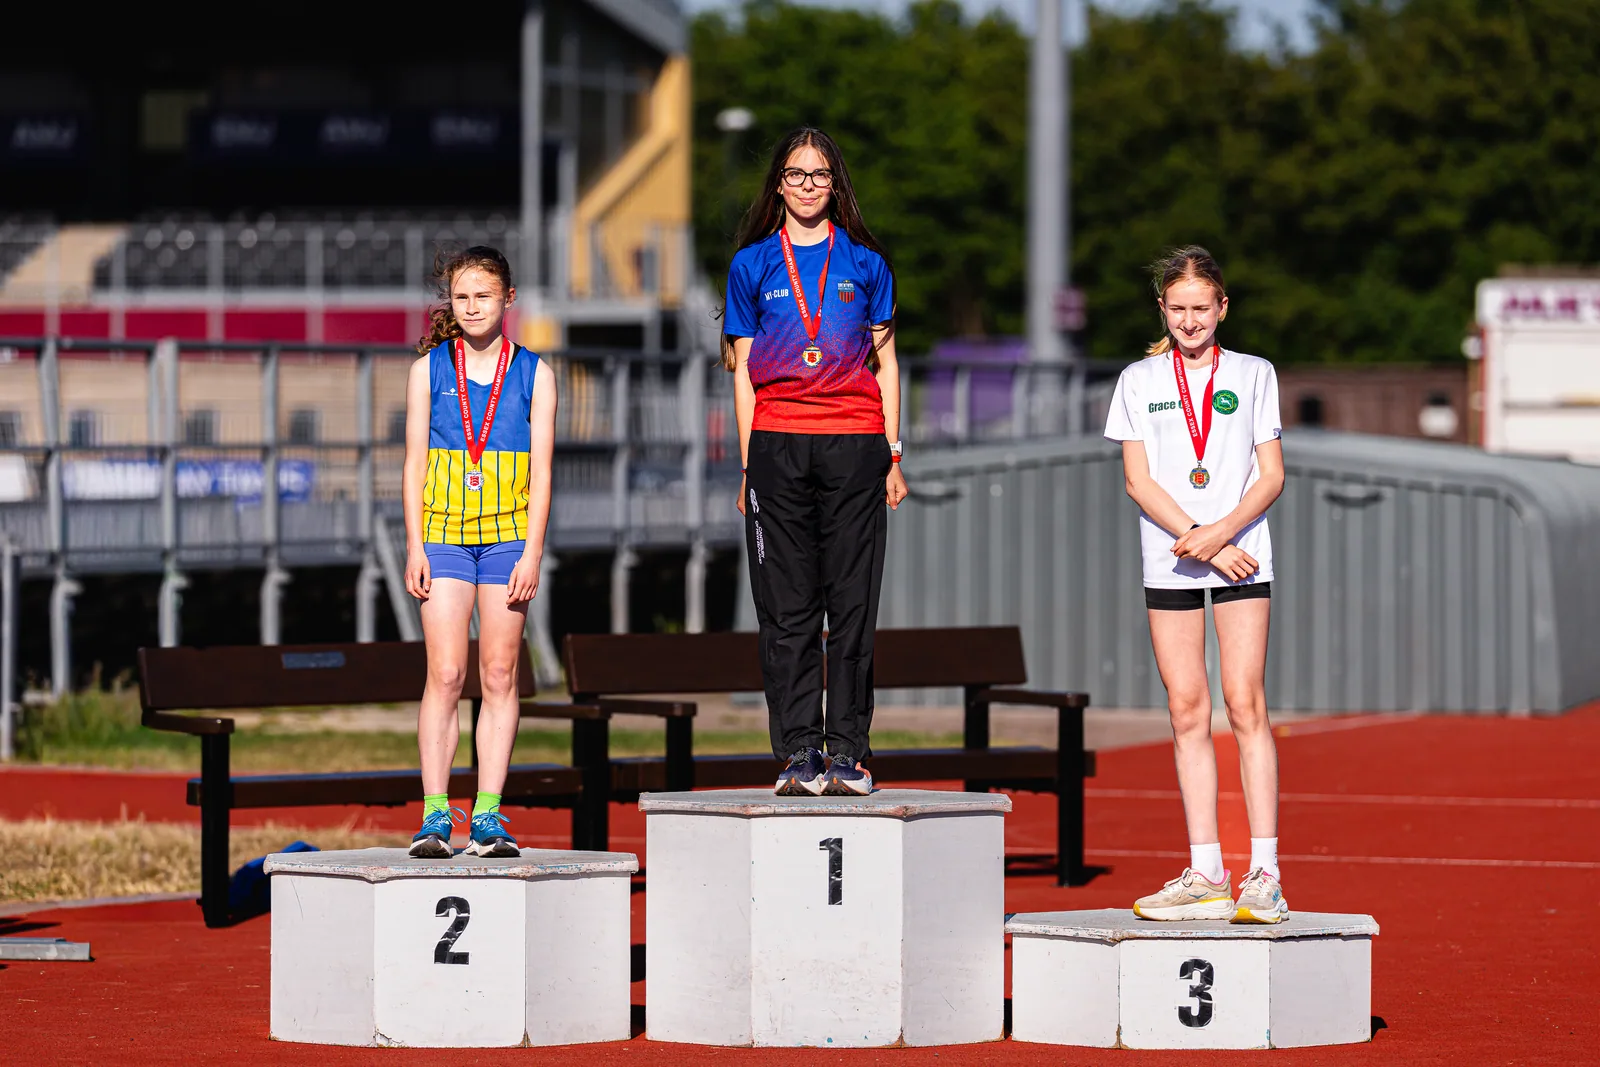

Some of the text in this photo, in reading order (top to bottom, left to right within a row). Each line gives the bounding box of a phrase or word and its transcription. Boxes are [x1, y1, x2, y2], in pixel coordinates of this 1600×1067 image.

[792, 275, 802, 297] COUNTY
[799, 299, 807, 318] ESSEX
[461, 394, 469, 418] COUNTY
[480, 352, 506, 442] ESSEX COUNTY CHAMPIONSHIP
[1149, 401, 1176, 413] Grace
[1183, 395, 1192, 416] COUNTY
[464, 420, 472, 440] ESSEX
[1188, 418, 1197, 437] ESSEX
[819, 837, 843, 905] 1
[434, 896, 470, 965] 2
[1178, 958, 1214, 1027] 3
